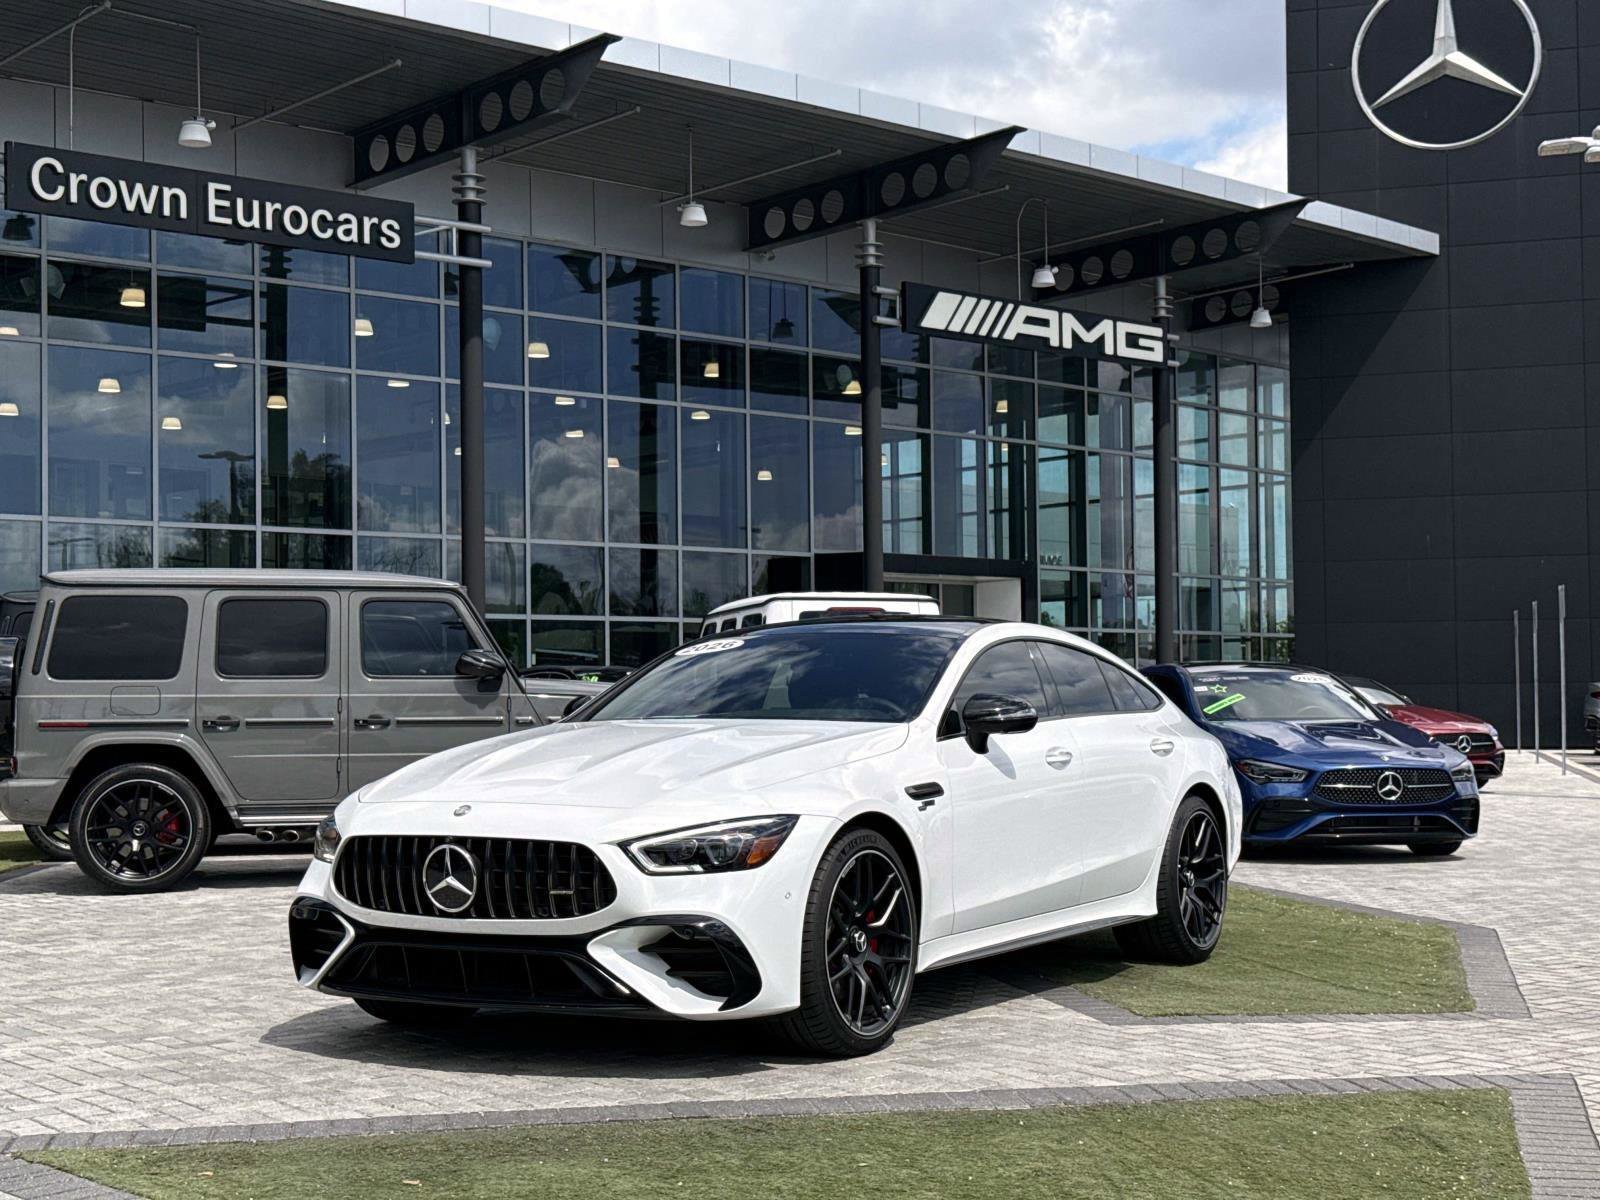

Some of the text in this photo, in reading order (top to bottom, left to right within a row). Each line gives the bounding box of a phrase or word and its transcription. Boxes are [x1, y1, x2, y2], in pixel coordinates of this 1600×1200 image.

[31, 157, 401, 249] Crown Eurocars
[1002, 305, 1164, 363] AMG
[681, 640, 738, 654] 2026
